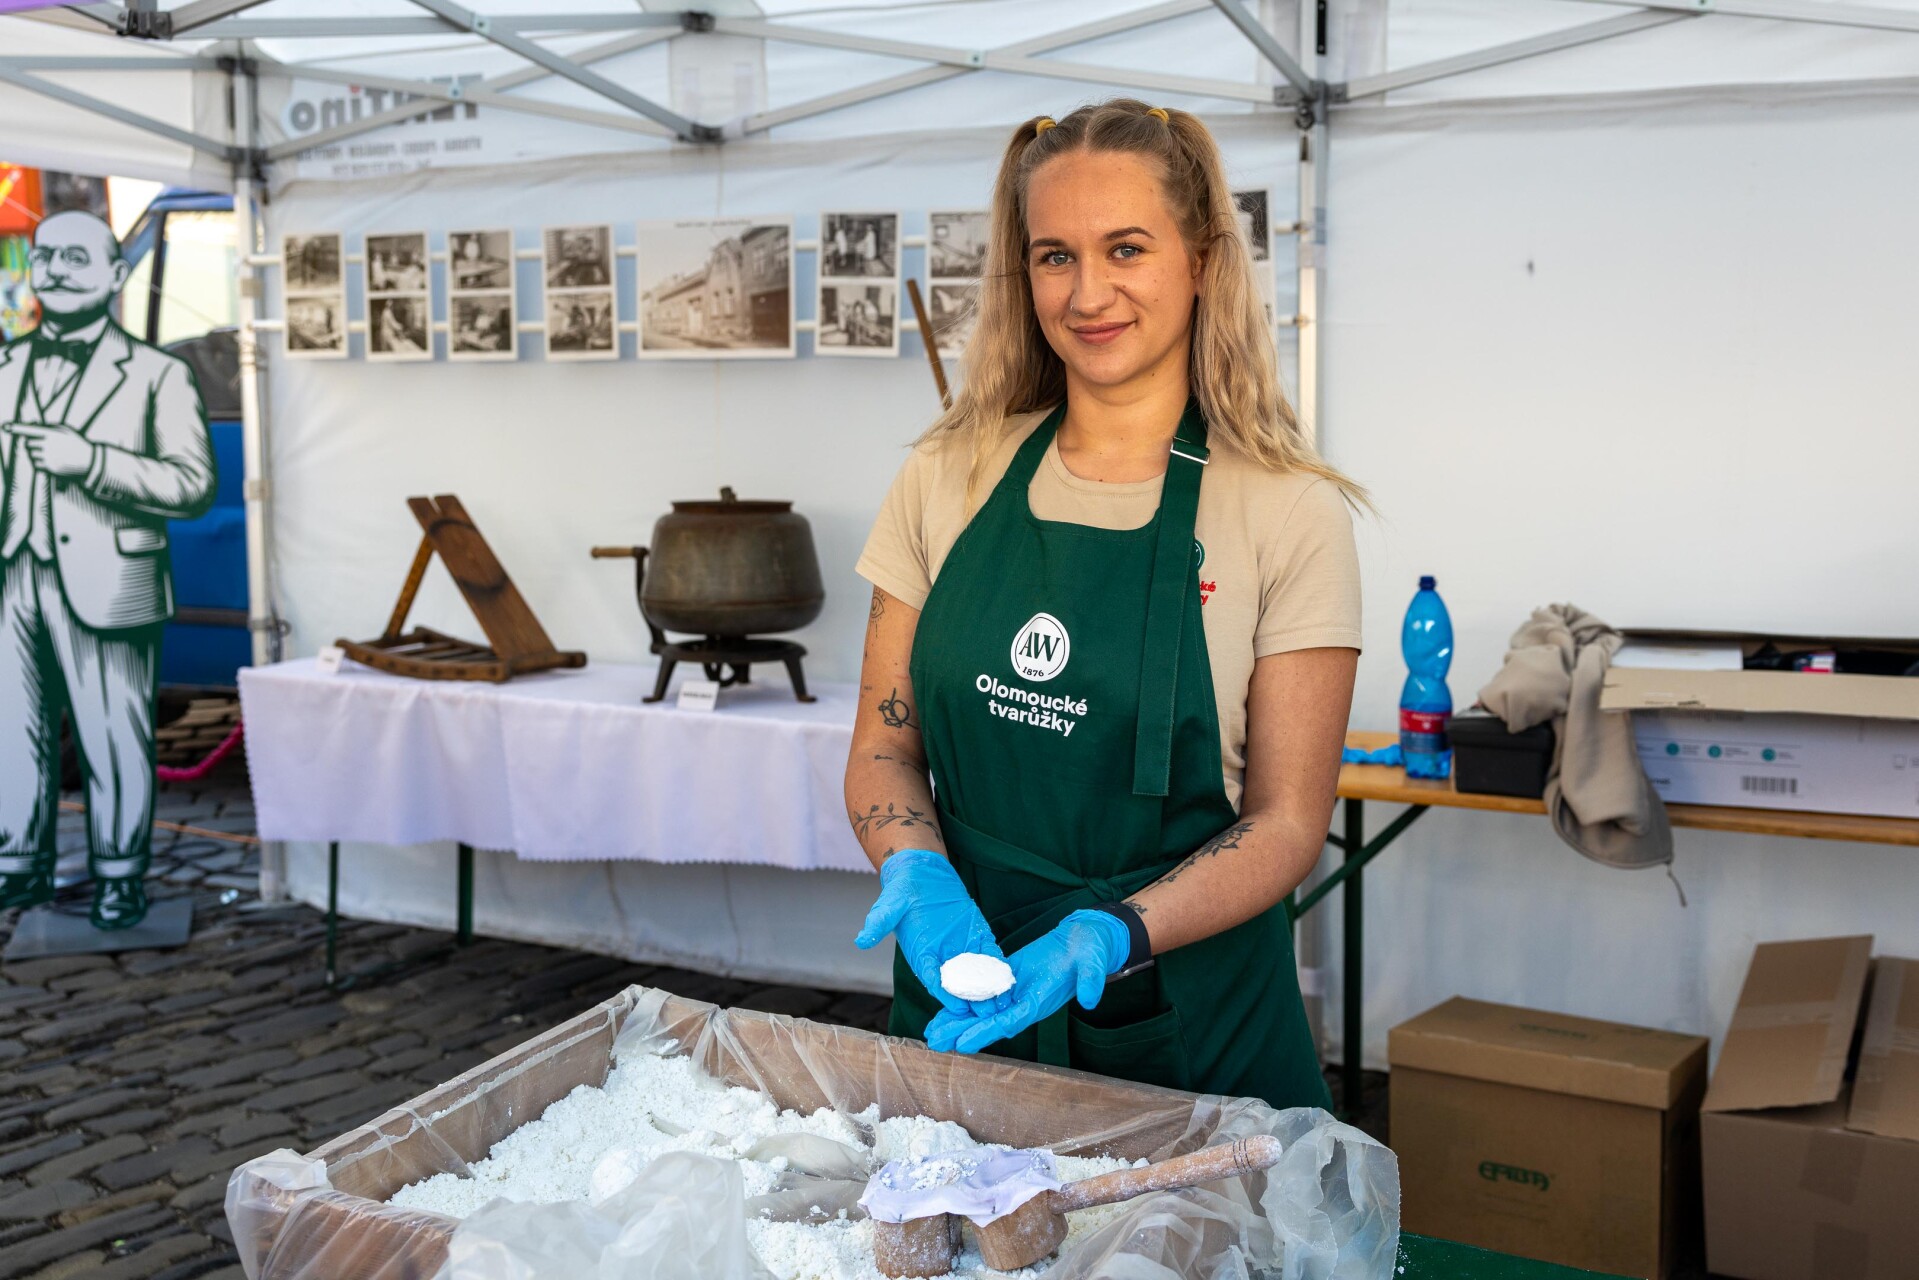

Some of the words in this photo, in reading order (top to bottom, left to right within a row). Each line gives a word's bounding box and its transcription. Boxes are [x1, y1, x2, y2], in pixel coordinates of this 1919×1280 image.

[1018, 631, 1061, 662] AW
[1022, 666, 1044, 677] 1876
[976, 674, 1088, 716] Olomoucké
[988, 699, 1075, 737] tvarůžky
